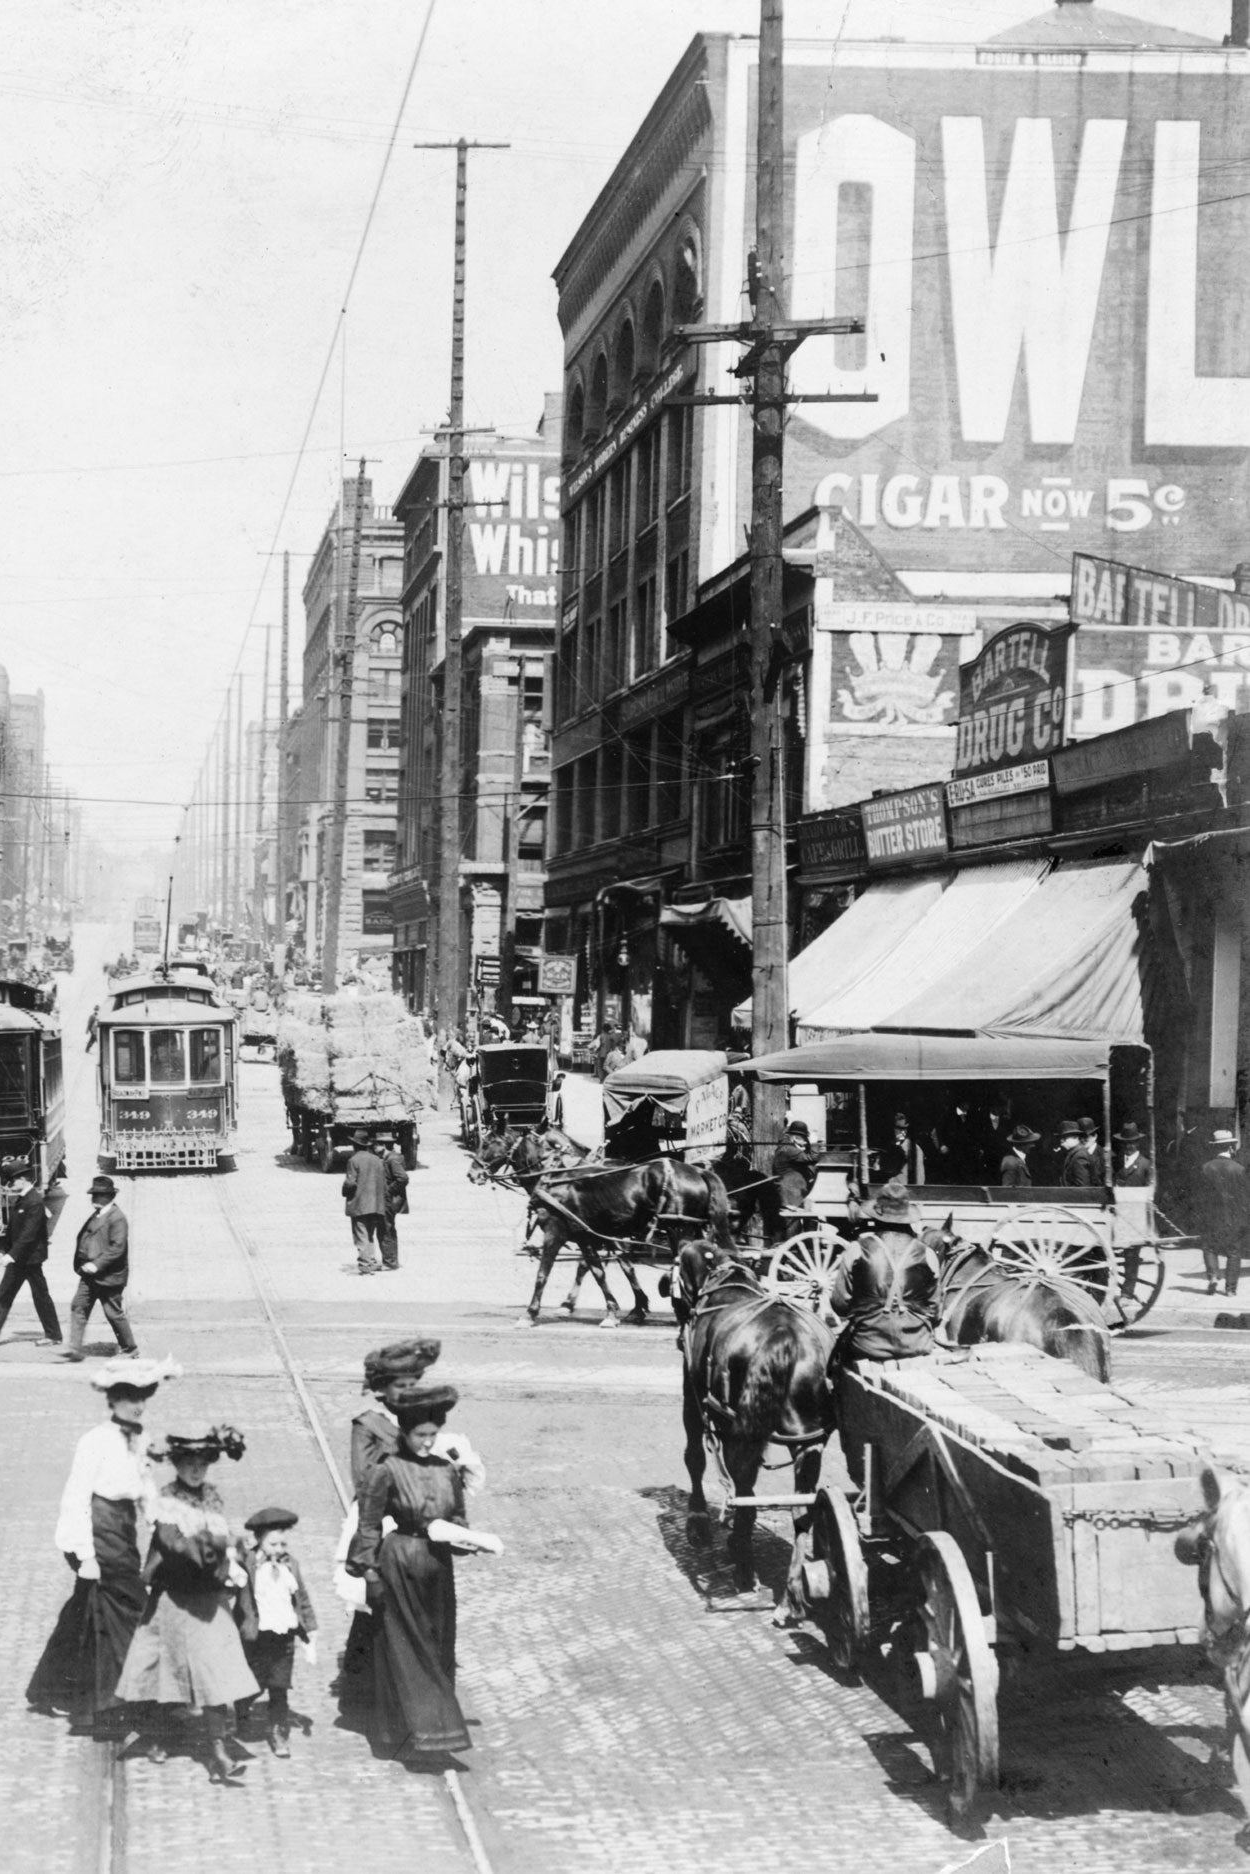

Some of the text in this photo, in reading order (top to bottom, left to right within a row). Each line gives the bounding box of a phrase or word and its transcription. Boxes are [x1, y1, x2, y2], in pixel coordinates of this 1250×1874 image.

[788, 113, 1250, 446] OWL
[814, 472, 1009, 529] CIGAR
[1020, 488, 1095, 518] NOW
[971, 631, 1050, 703] BARTELL
[957, 697, 1026, 770] DRUG
[865, 789, 939, 825] THOMPSON'S
[867, 823, 906, 859] BUTTER
[118, 1109, 151, 1120] 349
[185, 1108, 218, 1120] 349
